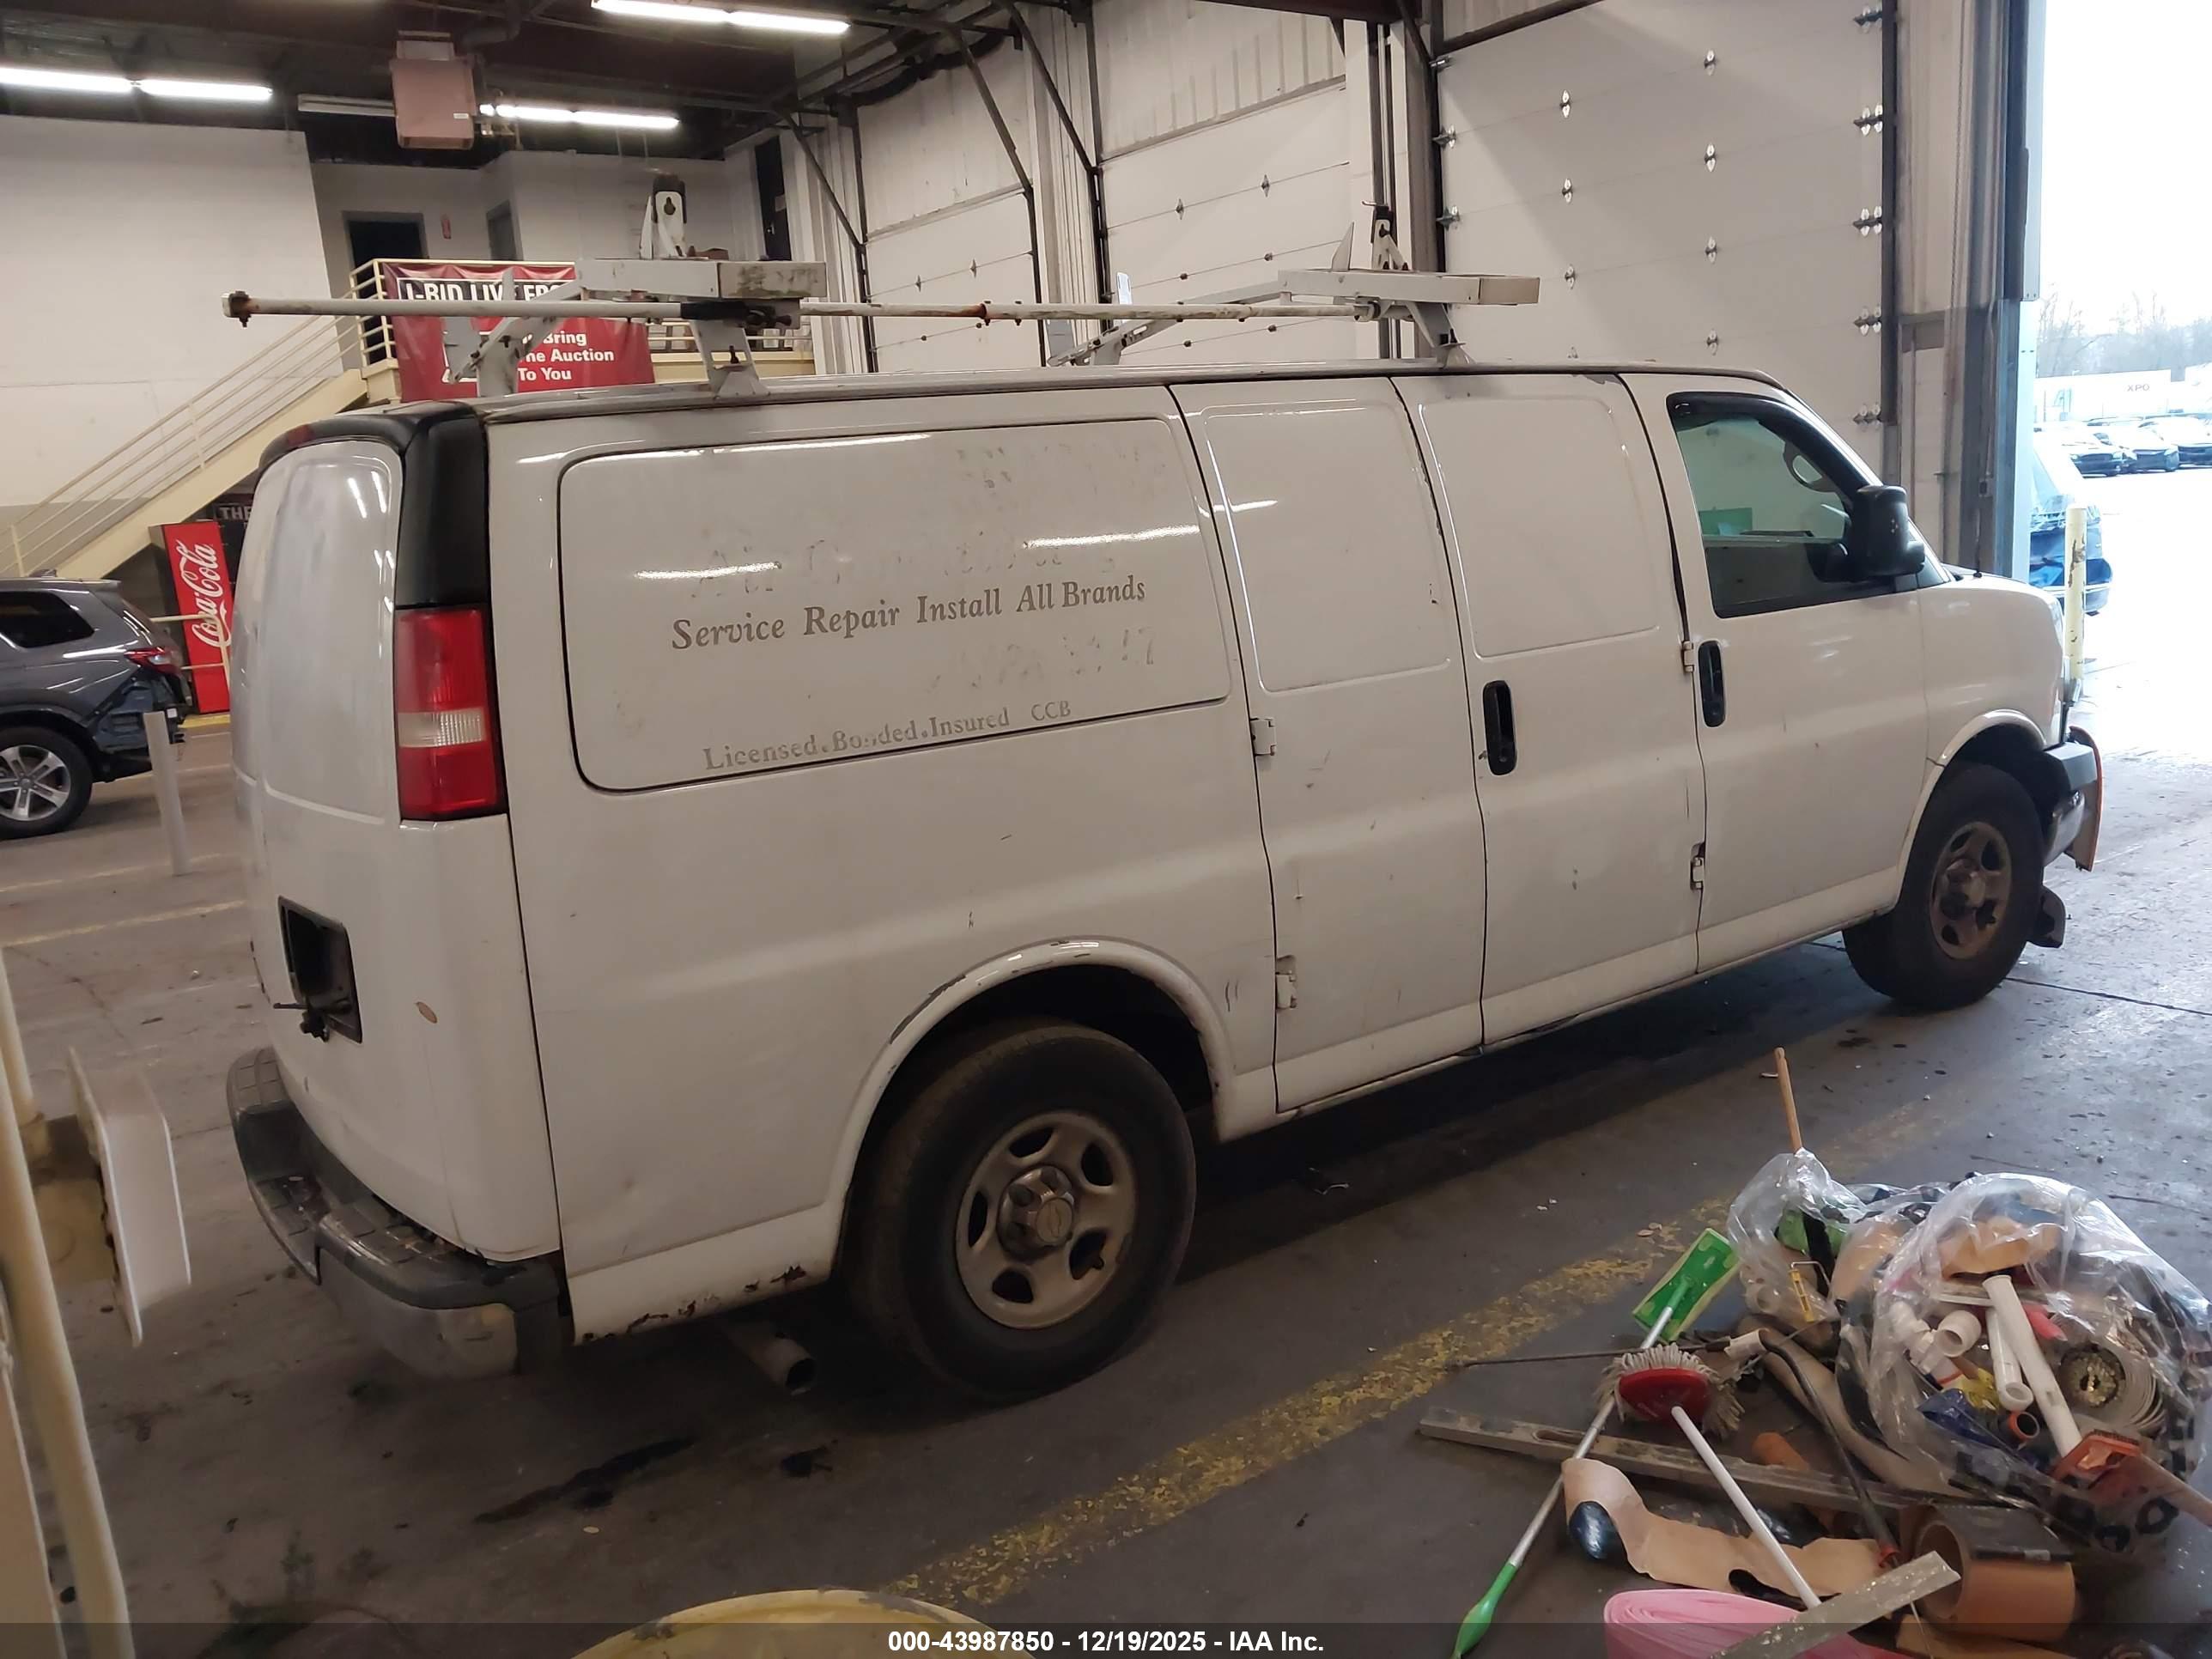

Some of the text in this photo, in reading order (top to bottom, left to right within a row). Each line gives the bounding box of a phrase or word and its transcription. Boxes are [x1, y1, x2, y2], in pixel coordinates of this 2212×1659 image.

[471, 283, 519, 301] LIV
[550, 348, 615, 362] Auction
[518, 367, 573, 381] To You
[672, 574, 1146, 650] Service Repair Install All Brands
[1030, 701, 1072, 721] CCB
